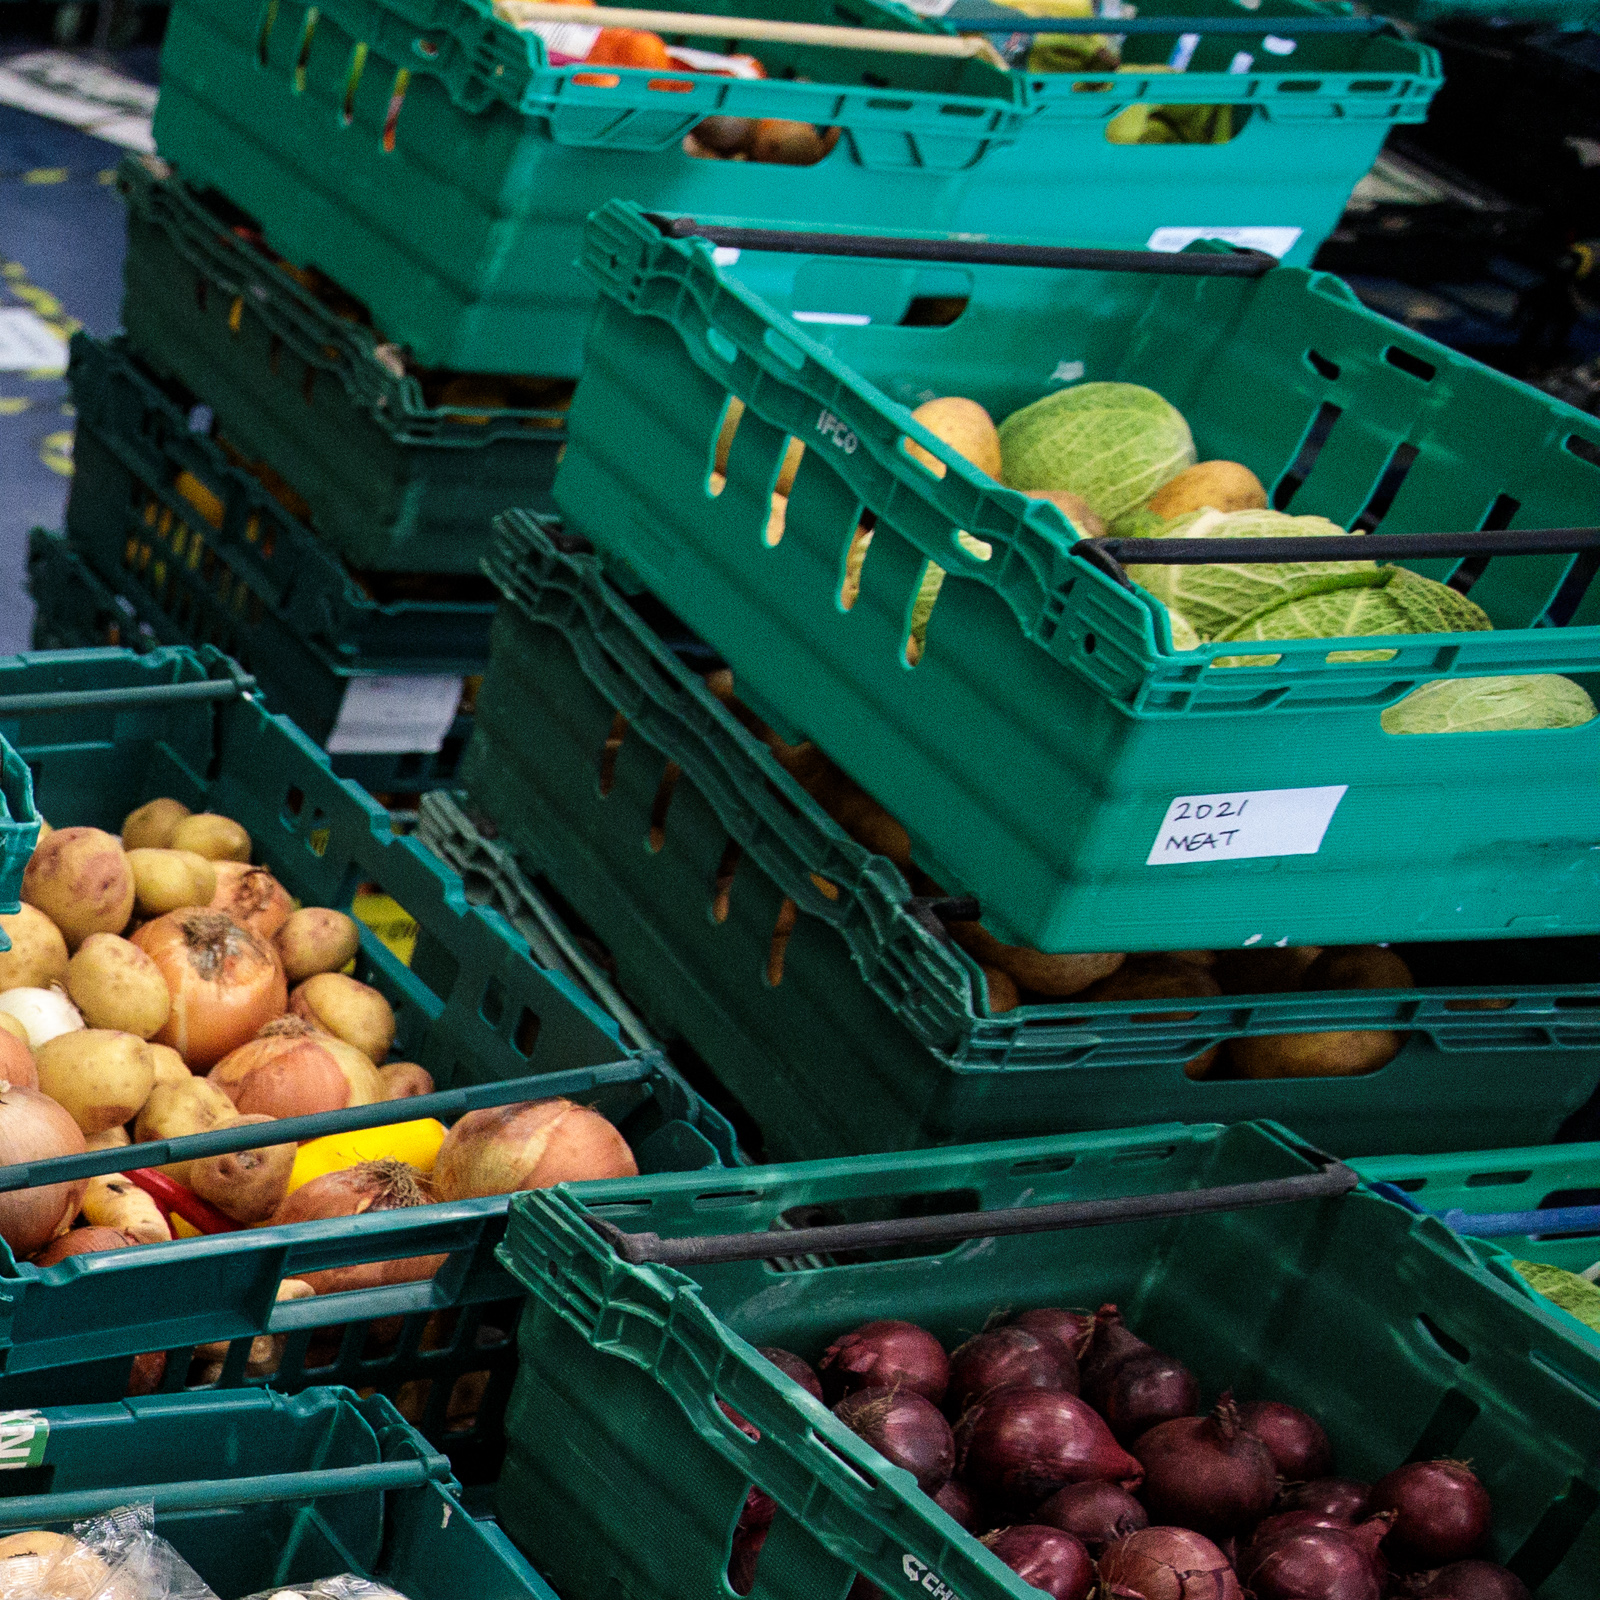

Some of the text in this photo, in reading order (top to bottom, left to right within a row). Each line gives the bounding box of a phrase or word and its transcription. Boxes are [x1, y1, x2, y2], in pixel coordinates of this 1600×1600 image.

[817, 409, 858, 453] IFCO
[1173, 799, 1249, 821] 2021
[1164, 829, 1240, 852] MEAT
